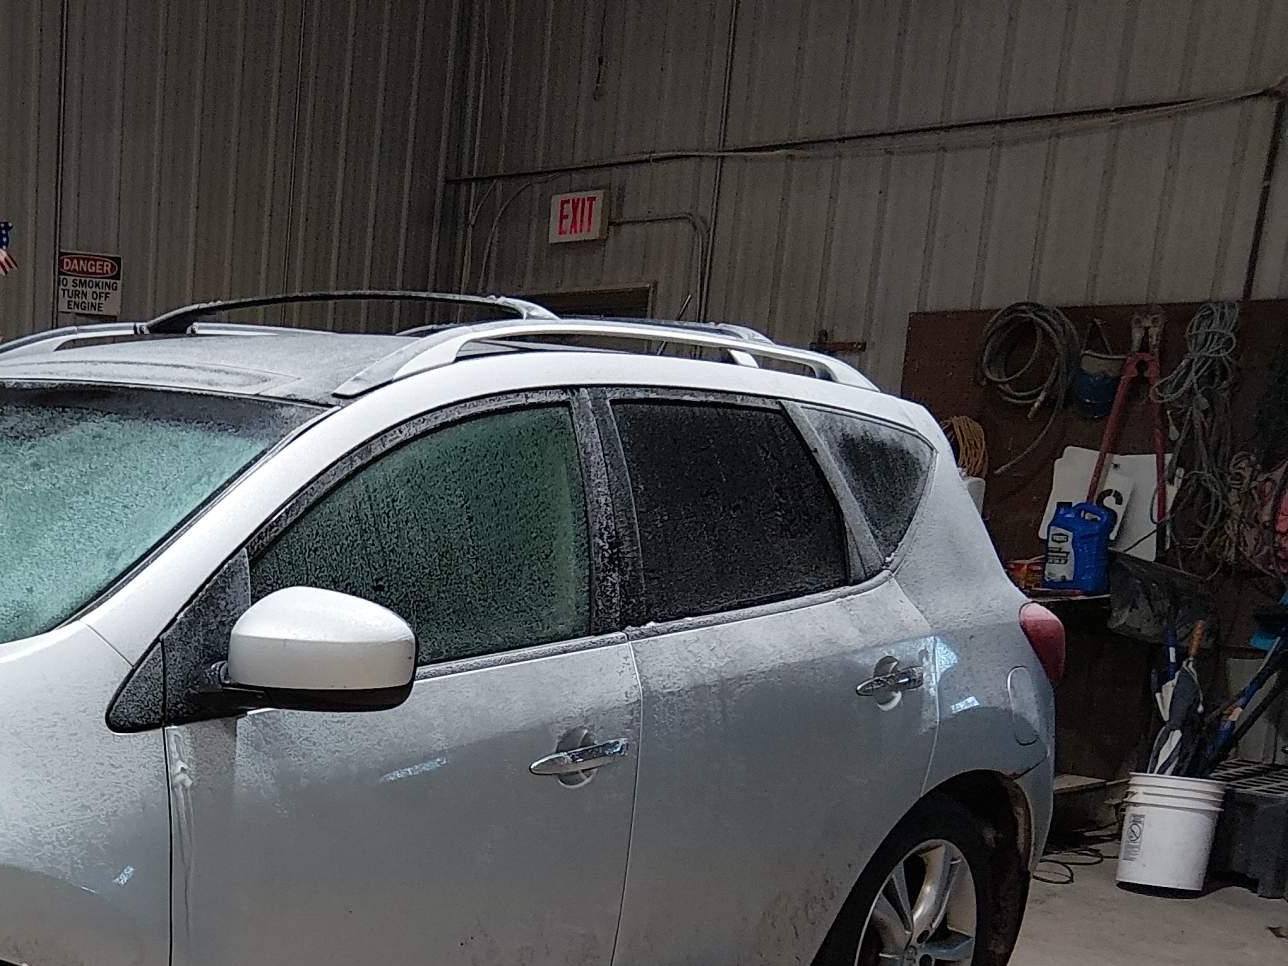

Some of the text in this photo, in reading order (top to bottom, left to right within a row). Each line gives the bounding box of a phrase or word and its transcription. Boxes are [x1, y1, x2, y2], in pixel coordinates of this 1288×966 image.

[558, 196, 597, 236] EXIT
[63, 258, 112, 274] DANGER
[72, 279, 118, 292] SMOKING
[61, 288, 111, 302] TURN OFF
[67, 300, 104, 312] ENGINE
